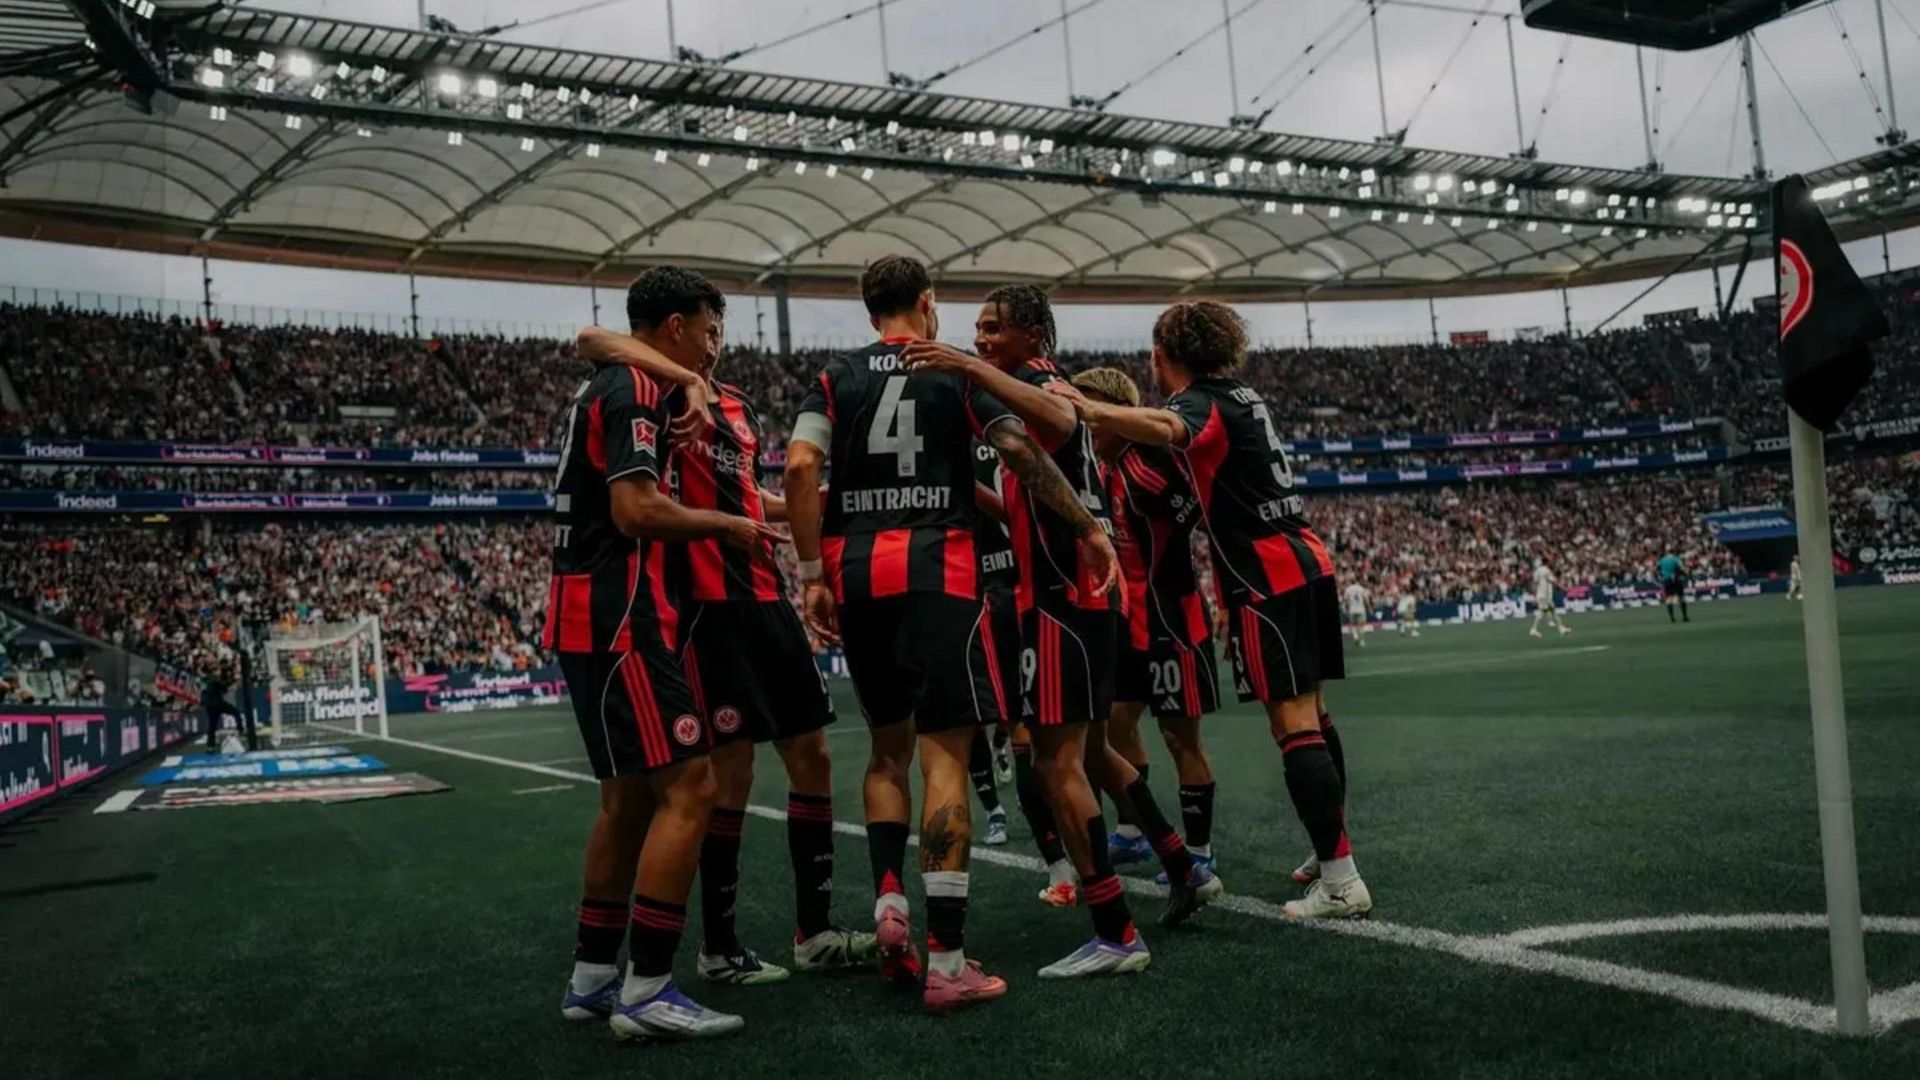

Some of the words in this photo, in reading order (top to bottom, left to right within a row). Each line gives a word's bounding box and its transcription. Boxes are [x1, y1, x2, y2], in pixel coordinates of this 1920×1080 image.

[867, 375, 924, 477] 4
[1252, 403, 1293, 488] 3
[841, 485, 951, 513] EINTRACHT
[1150, 660, 1182, 695] 20
